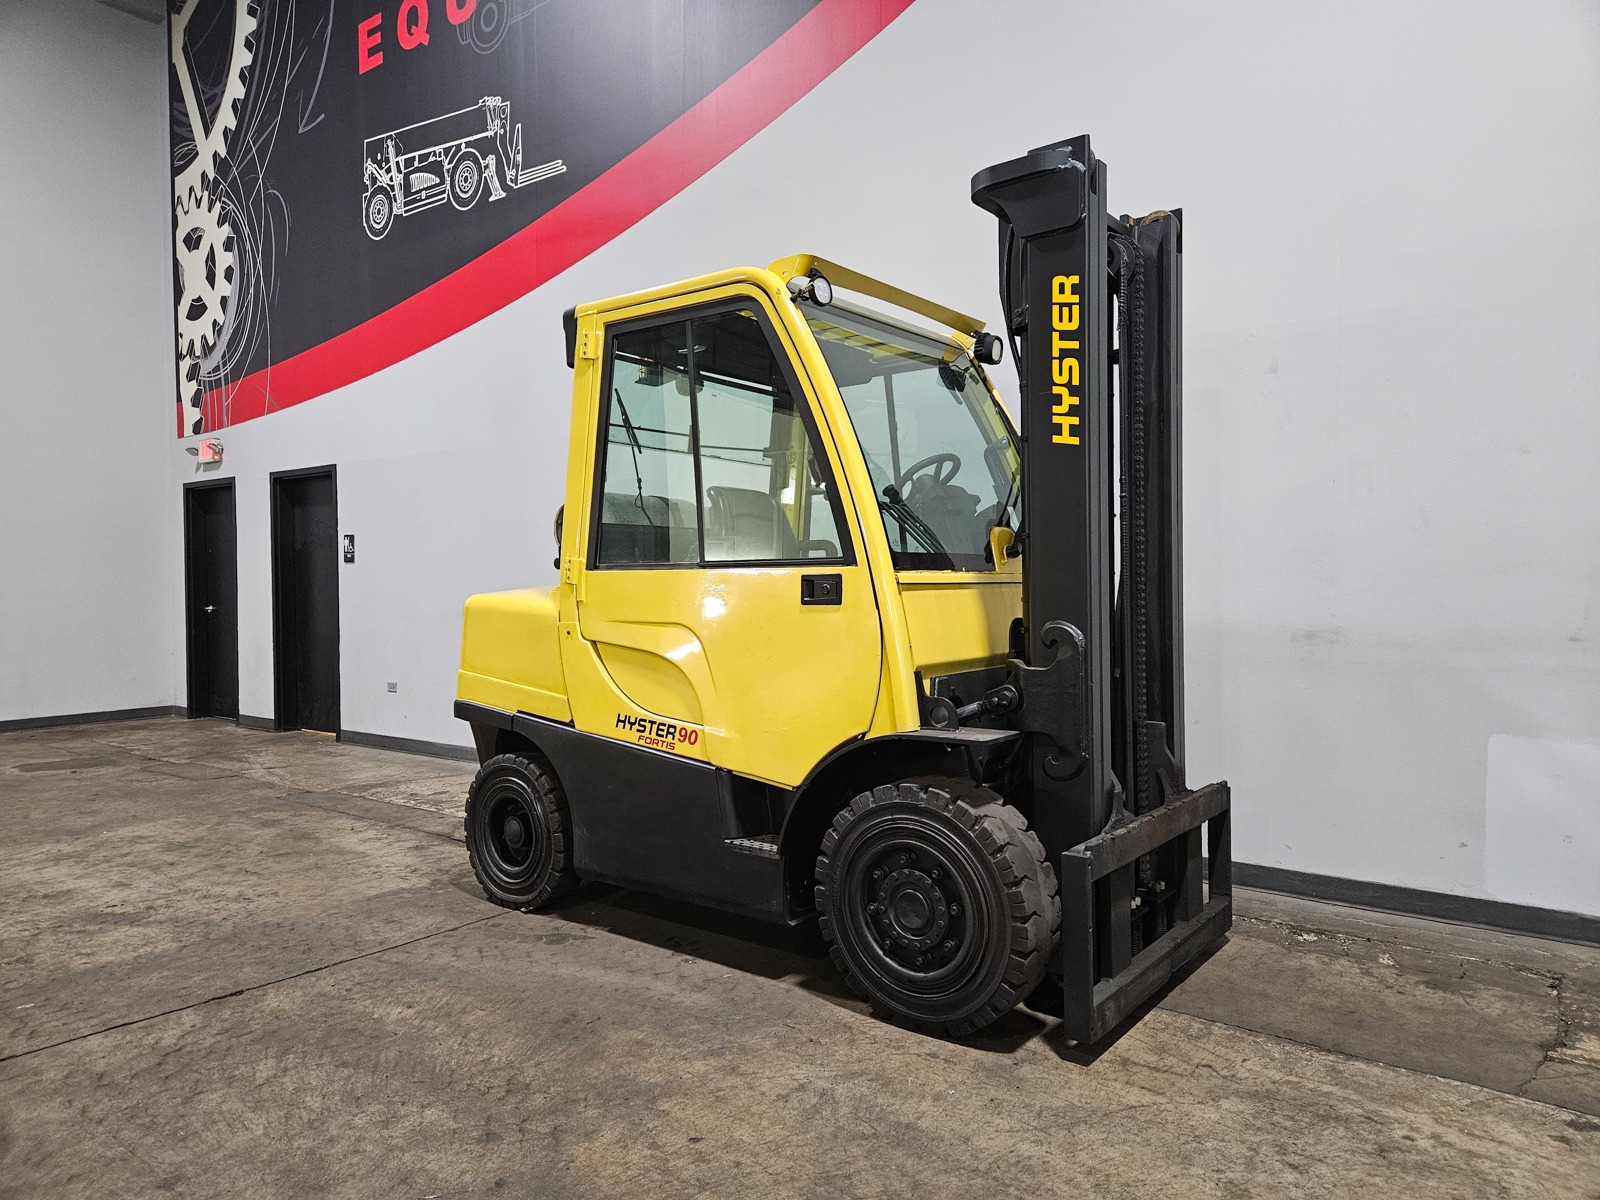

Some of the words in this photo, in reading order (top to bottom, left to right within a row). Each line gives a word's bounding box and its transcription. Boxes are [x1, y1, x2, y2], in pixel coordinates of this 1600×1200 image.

[1052, 275, 1080, 446] HYSTER
[616, 713, 677, 740] HYSTER
[677, 727, 699, 746] 90
[637, 735, 676, 750] FORTIS
